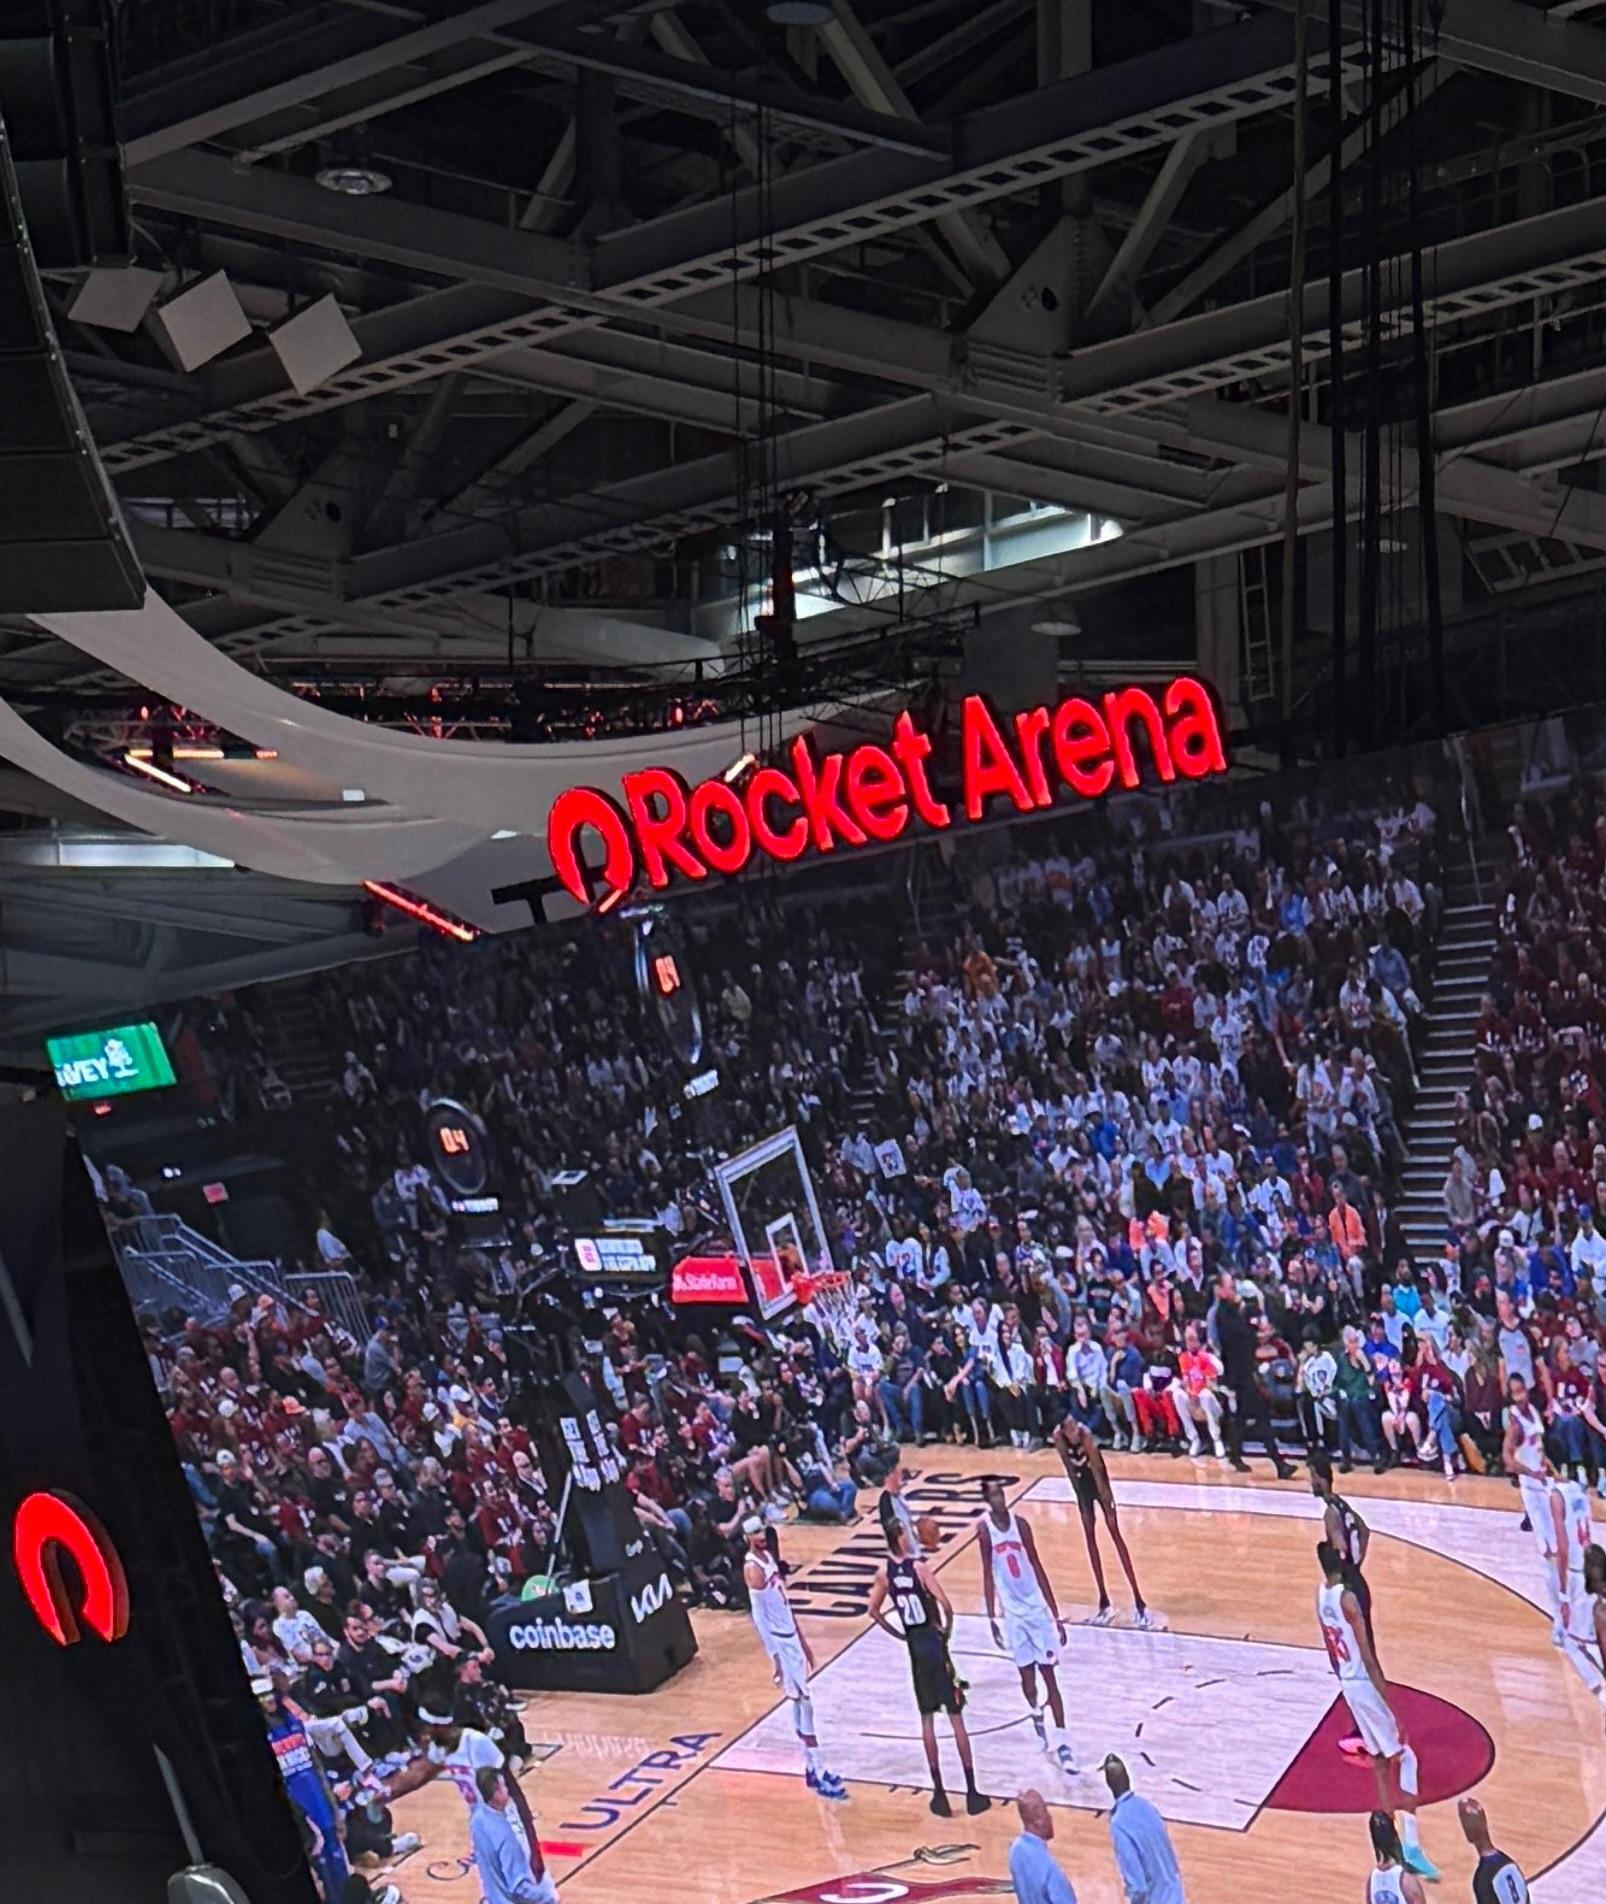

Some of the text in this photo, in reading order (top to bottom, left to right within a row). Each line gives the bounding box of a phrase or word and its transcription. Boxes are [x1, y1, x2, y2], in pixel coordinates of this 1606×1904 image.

[622, 676, 1227, 887] Rocket Arena
[509, 1617, 616, 1652] coinbase
[898, 1594, 927, 1627] 20
[560, 1730, 723, 1832] ULTRA
